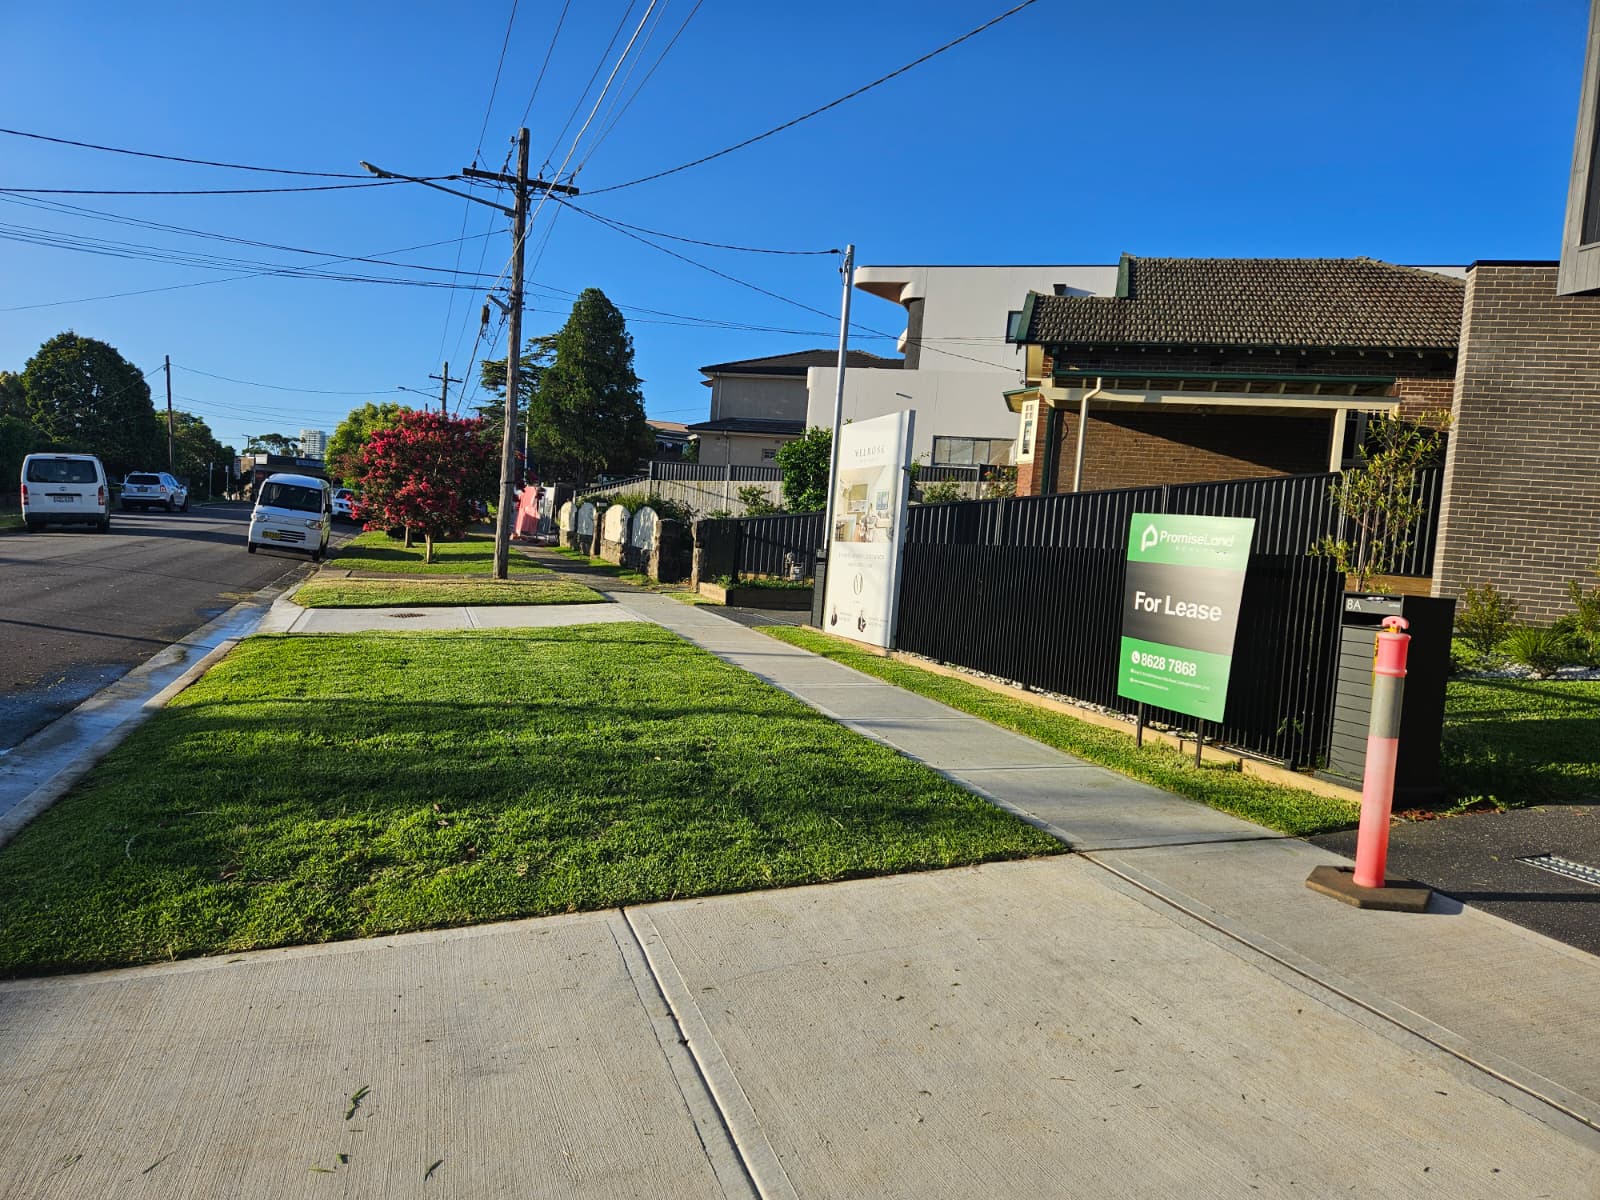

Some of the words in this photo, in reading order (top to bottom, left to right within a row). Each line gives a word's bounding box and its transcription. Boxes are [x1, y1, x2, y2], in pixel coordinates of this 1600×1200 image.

[1160, 530, 1234, 547] PromiseLand
[1134, 591, 1162, 613] For
[1164, 595, 1223, 621] Lease
[1346, 598, 1361, 610] 8A
[1141, 652, 1166, 671] 8628
[1168, 658, 1197, 677] 7868
